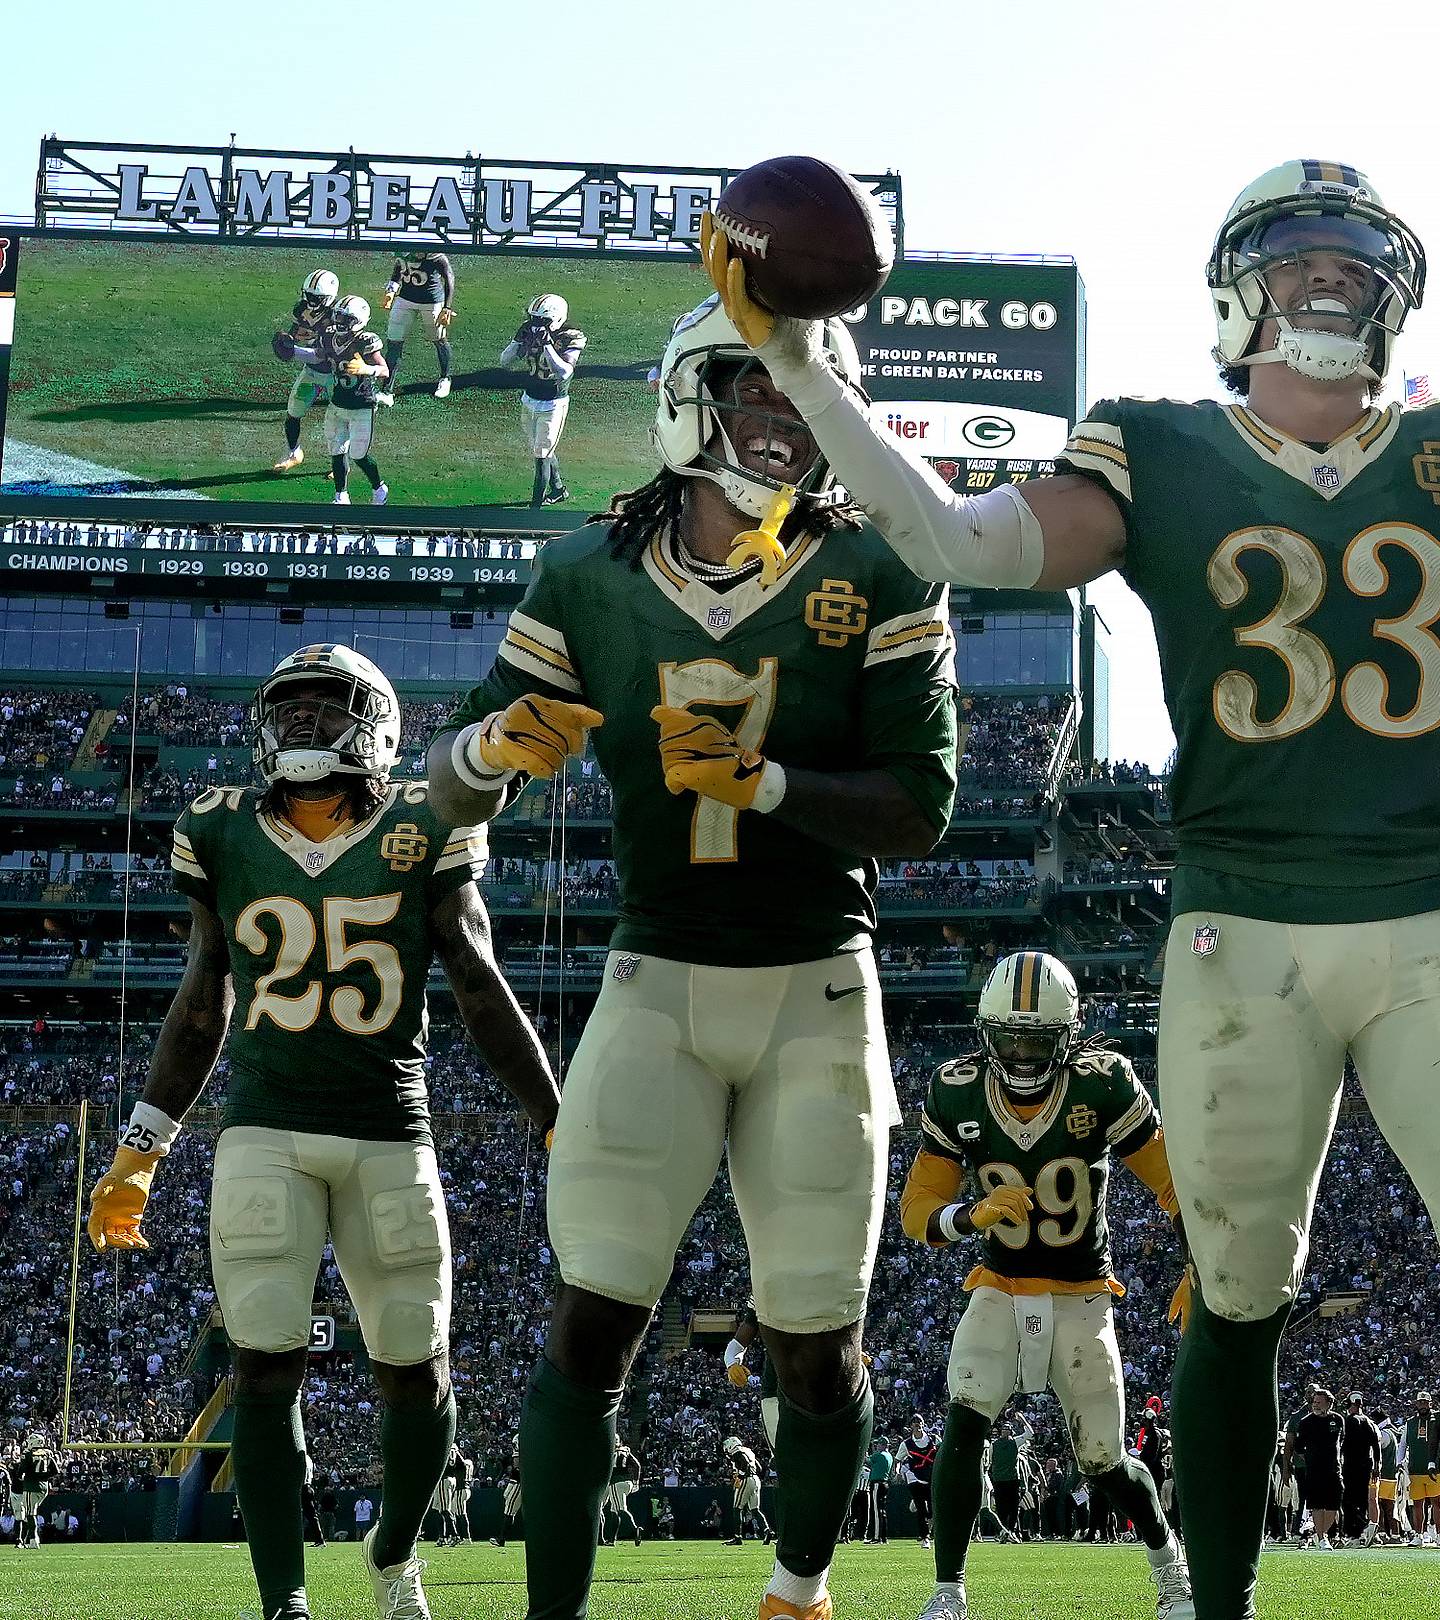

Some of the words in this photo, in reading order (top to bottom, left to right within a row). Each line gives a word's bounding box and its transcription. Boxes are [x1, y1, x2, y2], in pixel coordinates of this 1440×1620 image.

[115, 164, 532, 236] LAMBEAU
[579, 183, 712, 241] FIE
[881, 296, 990, 328] PACK
[1000, 300, 1058, 331] GO
[869, 348, 923, 362] PROUD
[926, 350, 998, 364] PARTNER
[860, 364, 877, 377] HE
[881, 365, 934, 379] GREEN
[937, 366, 969, 380] BAY
[972, 368, 1044, 383] PACKERS
[966, 459, 998, 471] YARDS
[1006, 460, 1033, 473] RUSH
[966, 472, 996, 488] 207
[8, 553, 129, 573] CHAMPIONS
[158, 559, 205, 576] 1929
[222, 561, 269, 577] 1930
[286, 563, 328, 579] 1931
[345, 564, 392, 580] 1936
[408, 566, 454, 582] 1939
[472, 567, 518, 583] 1944
[657, 656, 779, 864] 7
[235, 891, 405, 1035] 25
[122, 1123, 159, 1152] 25
[957, 1121, 981, 1139] C
